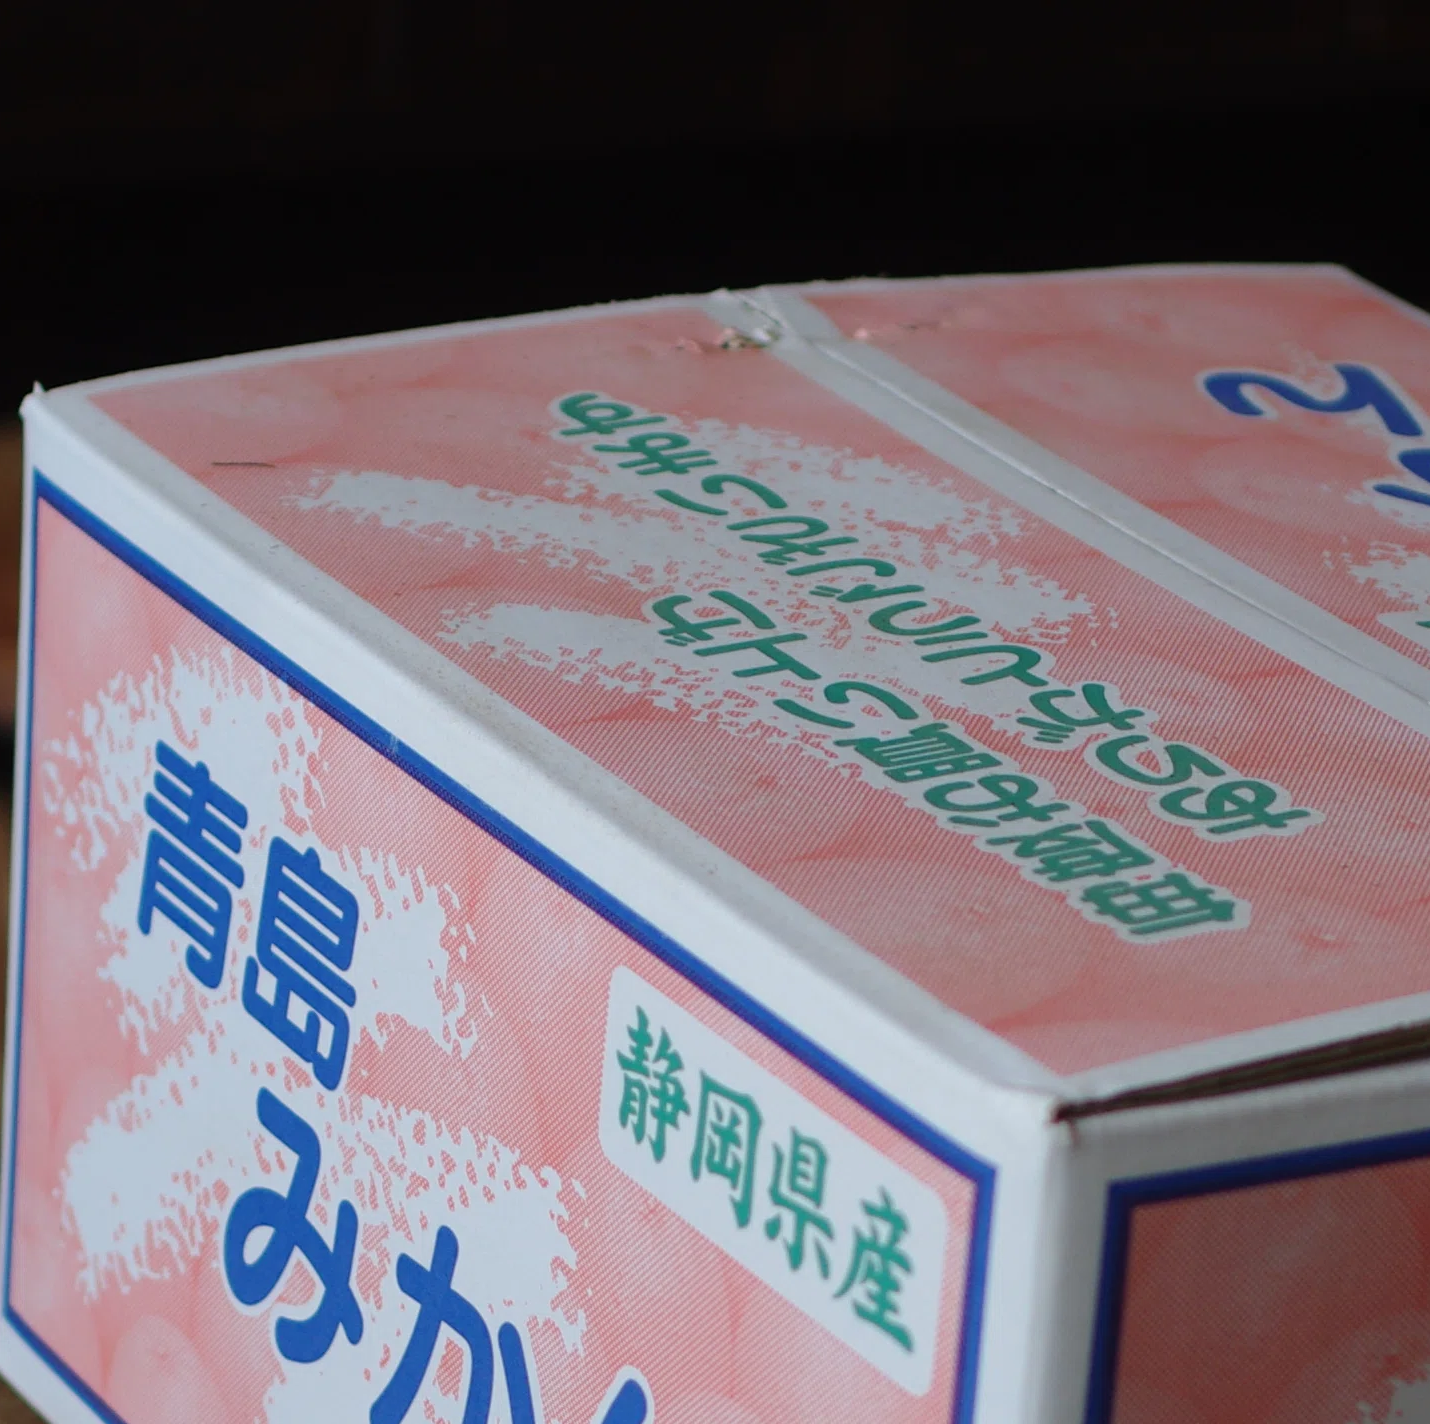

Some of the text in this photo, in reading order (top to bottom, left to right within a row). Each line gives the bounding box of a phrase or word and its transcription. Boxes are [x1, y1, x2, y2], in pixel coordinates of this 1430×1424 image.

[561, 393, 1311, 836] ありがとうございます
[652, 591, 1236, 935] 毎度お買い上げ
[138, 741, 360, 1091] 青島
[616, 1006, 914, 1353] 静岡県産
